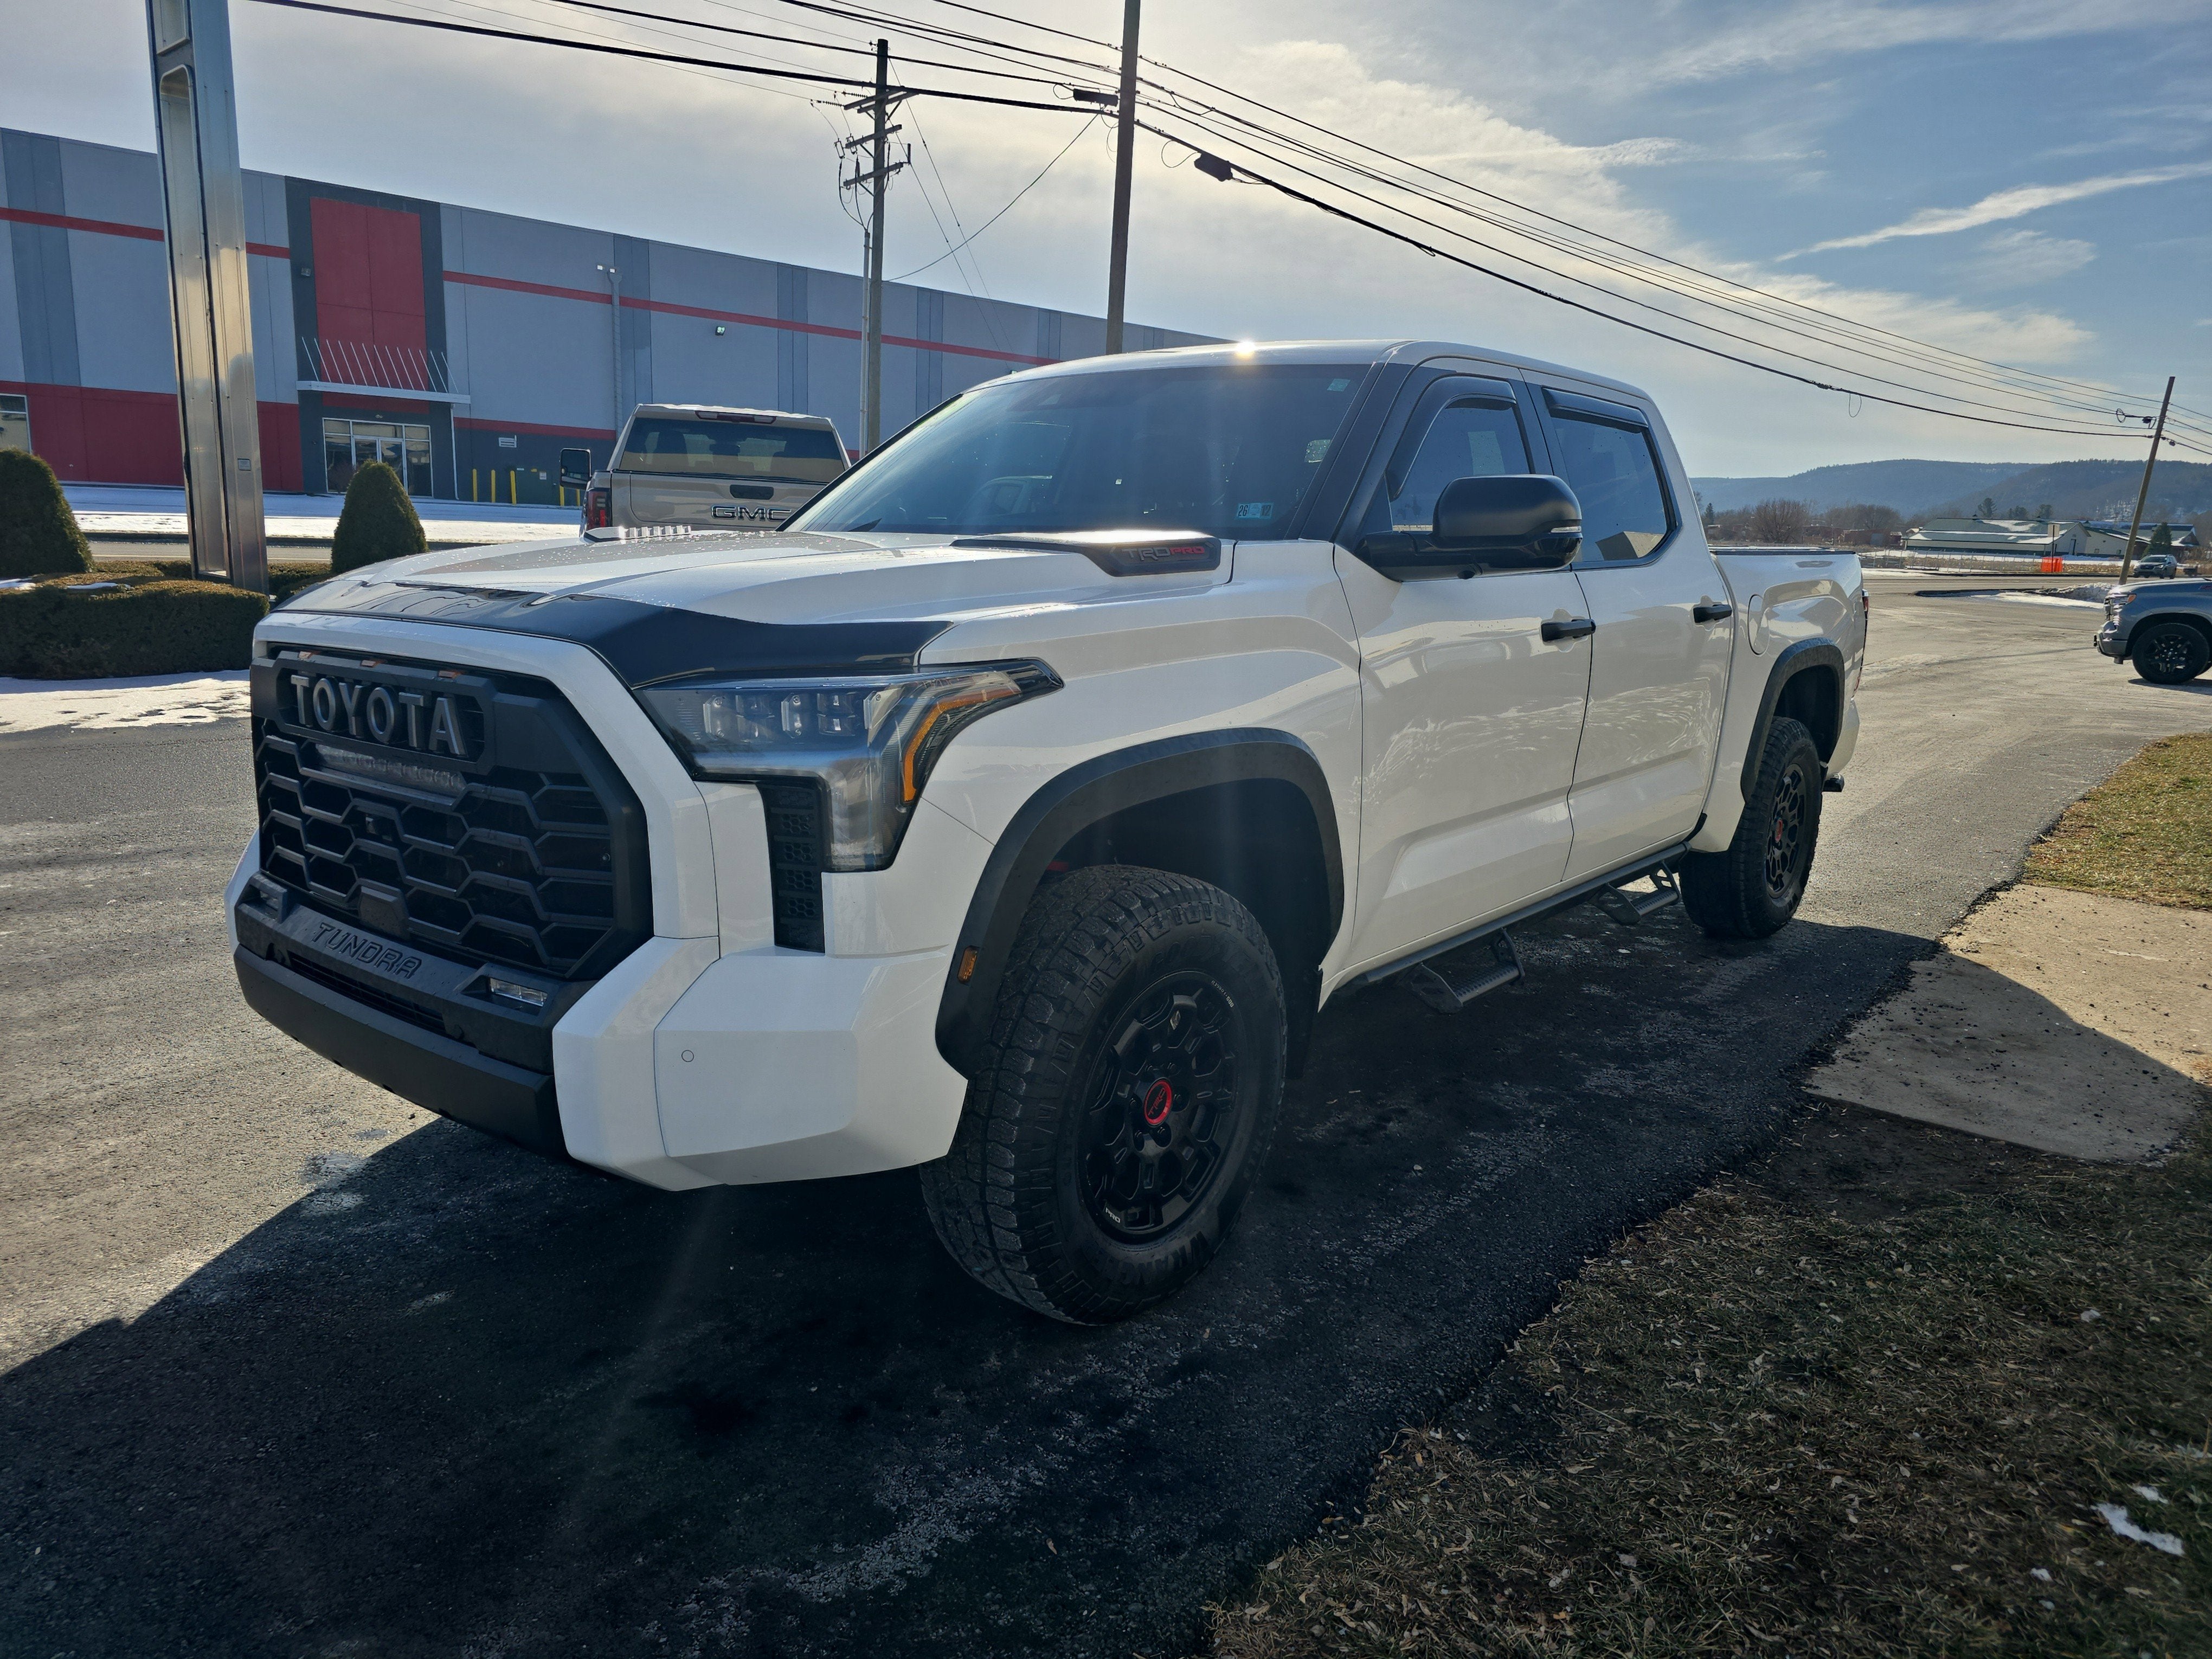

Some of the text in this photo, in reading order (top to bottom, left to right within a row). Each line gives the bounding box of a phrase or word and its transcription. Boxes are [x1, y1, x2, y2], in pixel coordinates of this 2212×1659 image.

[711, 505, 792, 522] GMC
[1238, 505, 1248, 517] 26
[1122, 546, 1205, 561] TRD PRO
[291, 675, 468, 757] TOYOTA
[311, 922, 422, 980] TUNDRA
[1105, 1207, 1120, 1224] PRO
